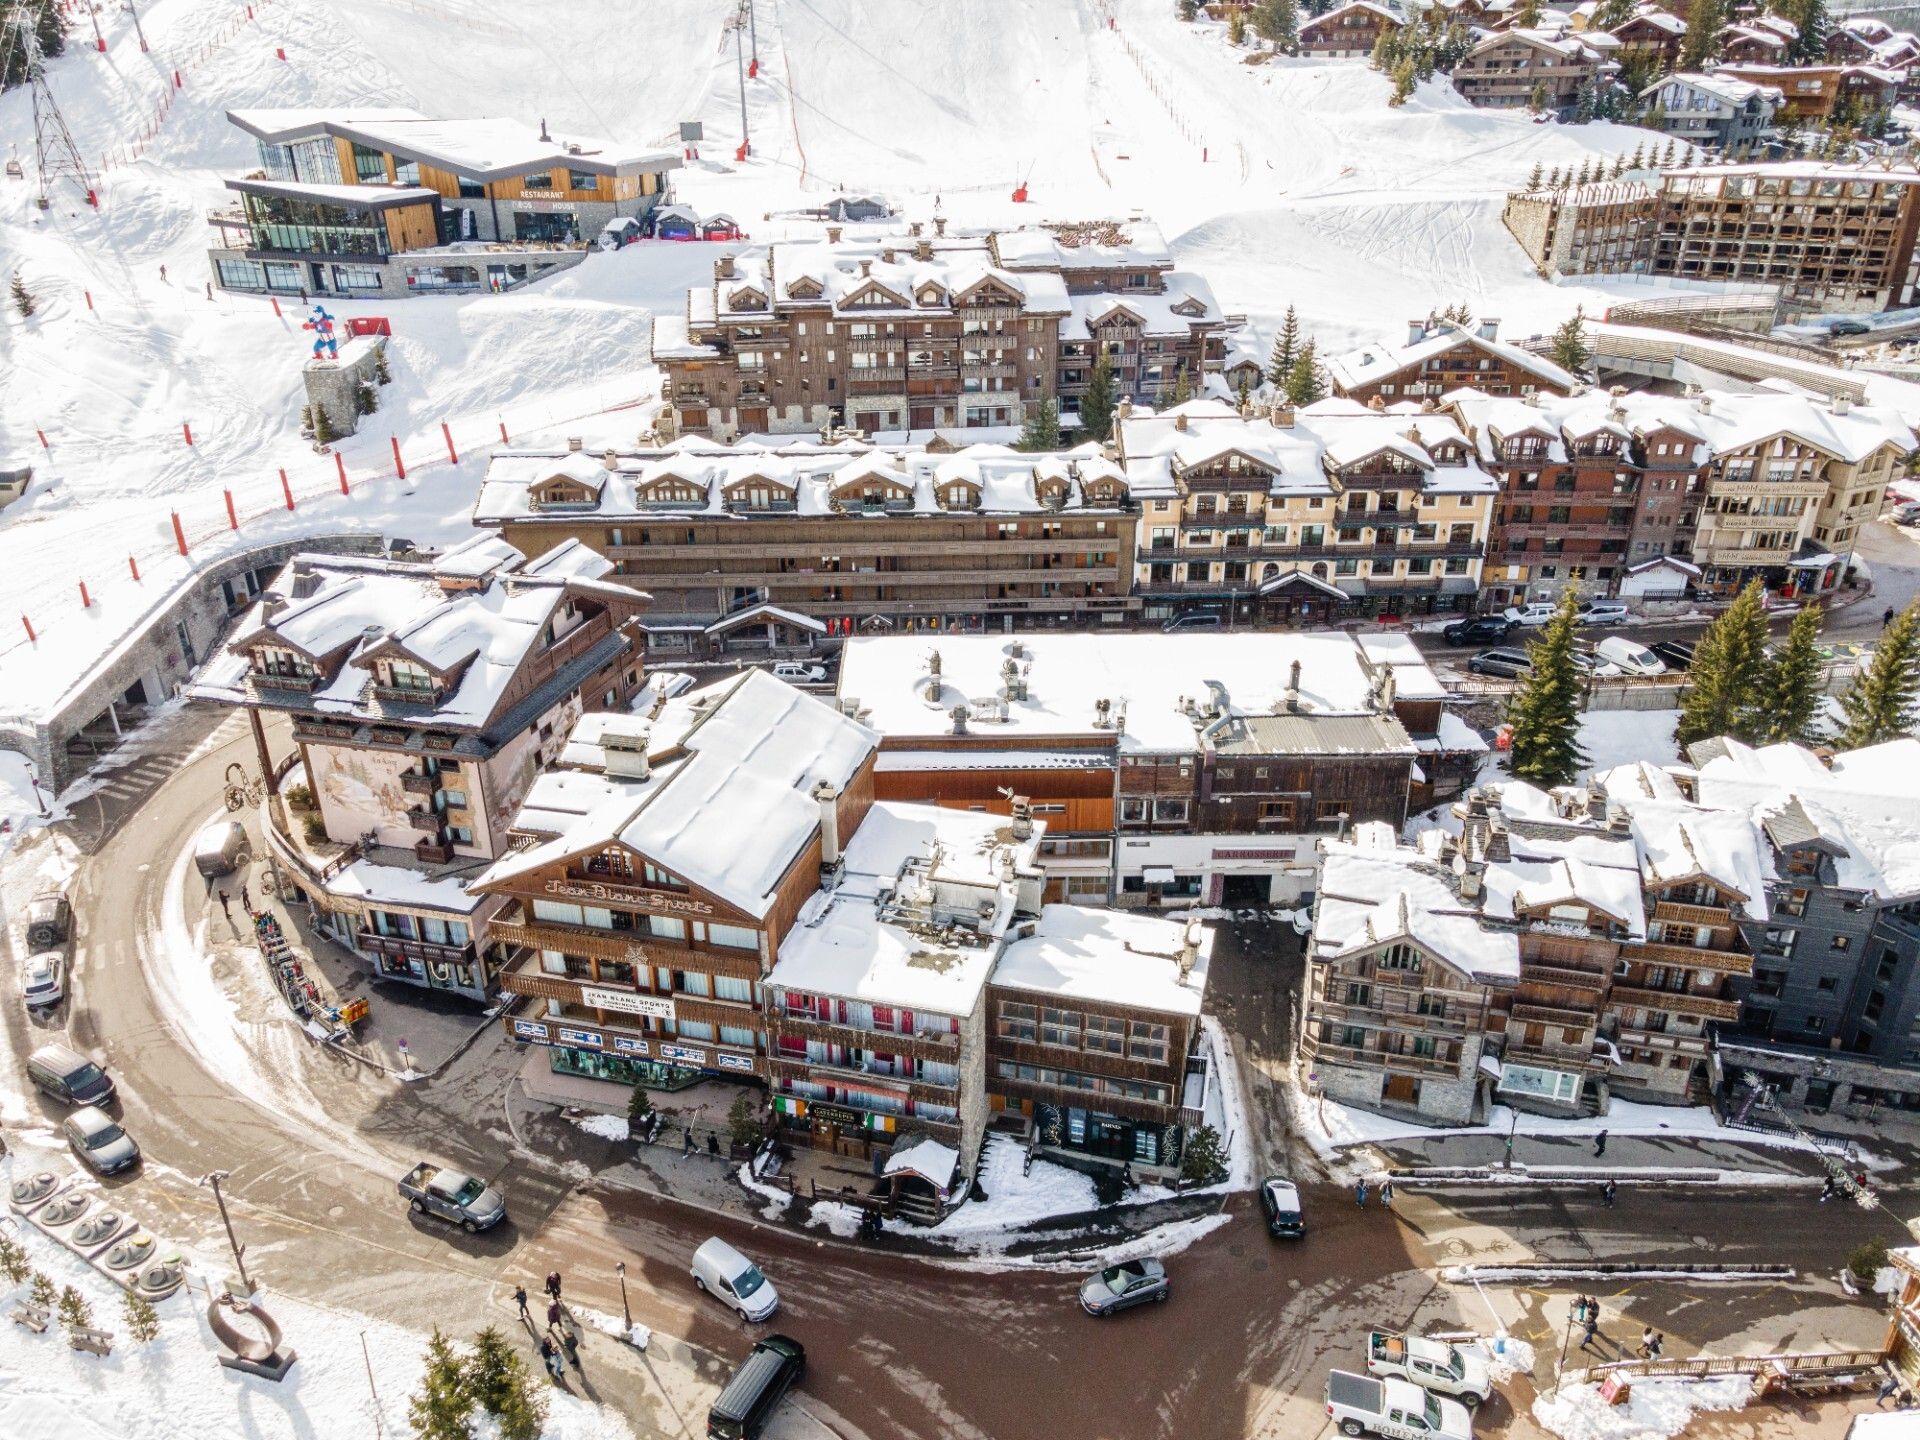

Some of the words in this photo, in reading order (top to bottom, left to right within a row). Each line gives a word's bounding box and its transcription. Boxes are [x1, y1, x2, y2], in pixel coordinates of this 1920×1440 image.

[519, 191, 565, 199] RESTAURANT
[552, 202, 576, 210] HOUSE
[1082, 231, 1092, 245] 3
[1217, 850, 1290, 858] CARROSSERIE
[545, 880, 587, 896] Jean
[592, 885, 647, 904] Blanc
[650, 894, 714, 914] Sports
[610, 995, 636, 1004] BLANC
[639, 1000, 670, 1009] SPORTS
